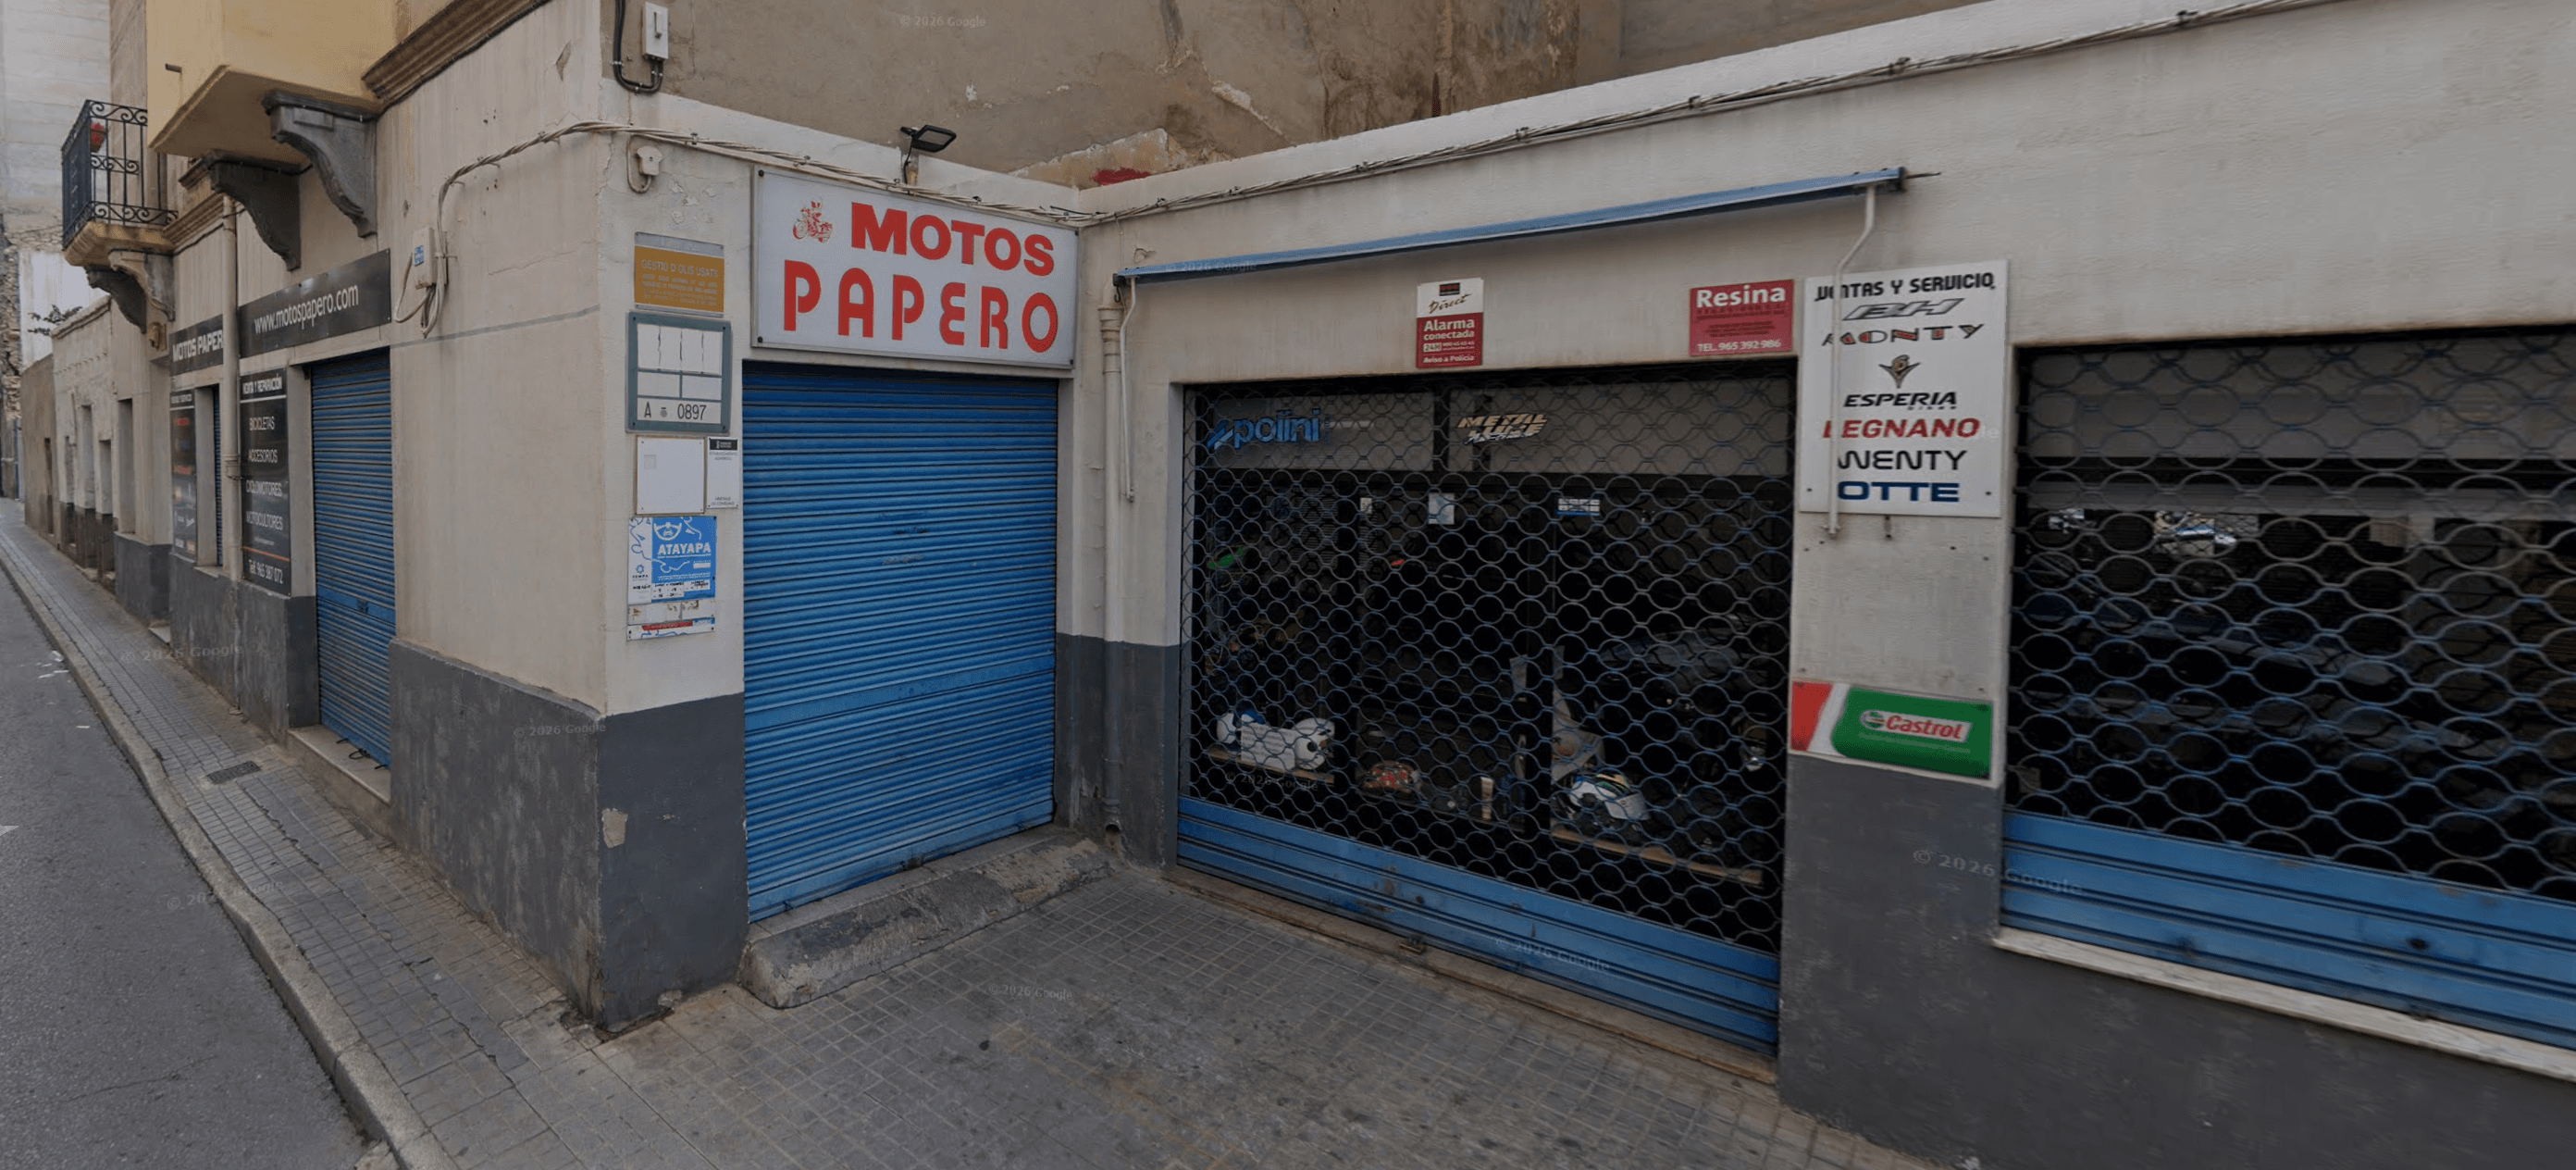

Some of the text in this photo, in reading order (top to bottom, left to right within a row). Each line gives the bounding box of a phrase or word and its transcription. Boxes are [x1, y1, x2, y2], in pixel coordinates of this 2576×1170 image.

[851, 201, 1054, 277] MOTOS
[1890, 280, 1903, 294] Y
[1909, 272, 1996, 293] SERVICIO
[1428, 293, 1473, 314] Direct
[1697, 285, 1786, 308] Resina
[254, 284, 359, 334] www.motospapero.com
[784, 259, 1059, 353] PAPERO
[1423, 318, 1475, 331] Alarma
[1423, 330, 1475, 341] conectada
[172, 339, 197, 362] MOTOS
[1425, 343, 1441, 352] 24H
[1718, 342, 1739, 351] 965
[1740, 341, 1759, 349] 392
[1843, 392, 1957, 407] ESPERIA
[644, 402, 707, 420] A 0897
[249, 416, 275, 430] BICICLETAS
[1233, 407, 1321, 450] polini
[1457, 413, 1548, 429] METAL
[248, 449, 278, 463] ACCESORIOS
[657, 541, 712, 555] ATAYAPA
[1886, 716, 1964, 739] Castrol
